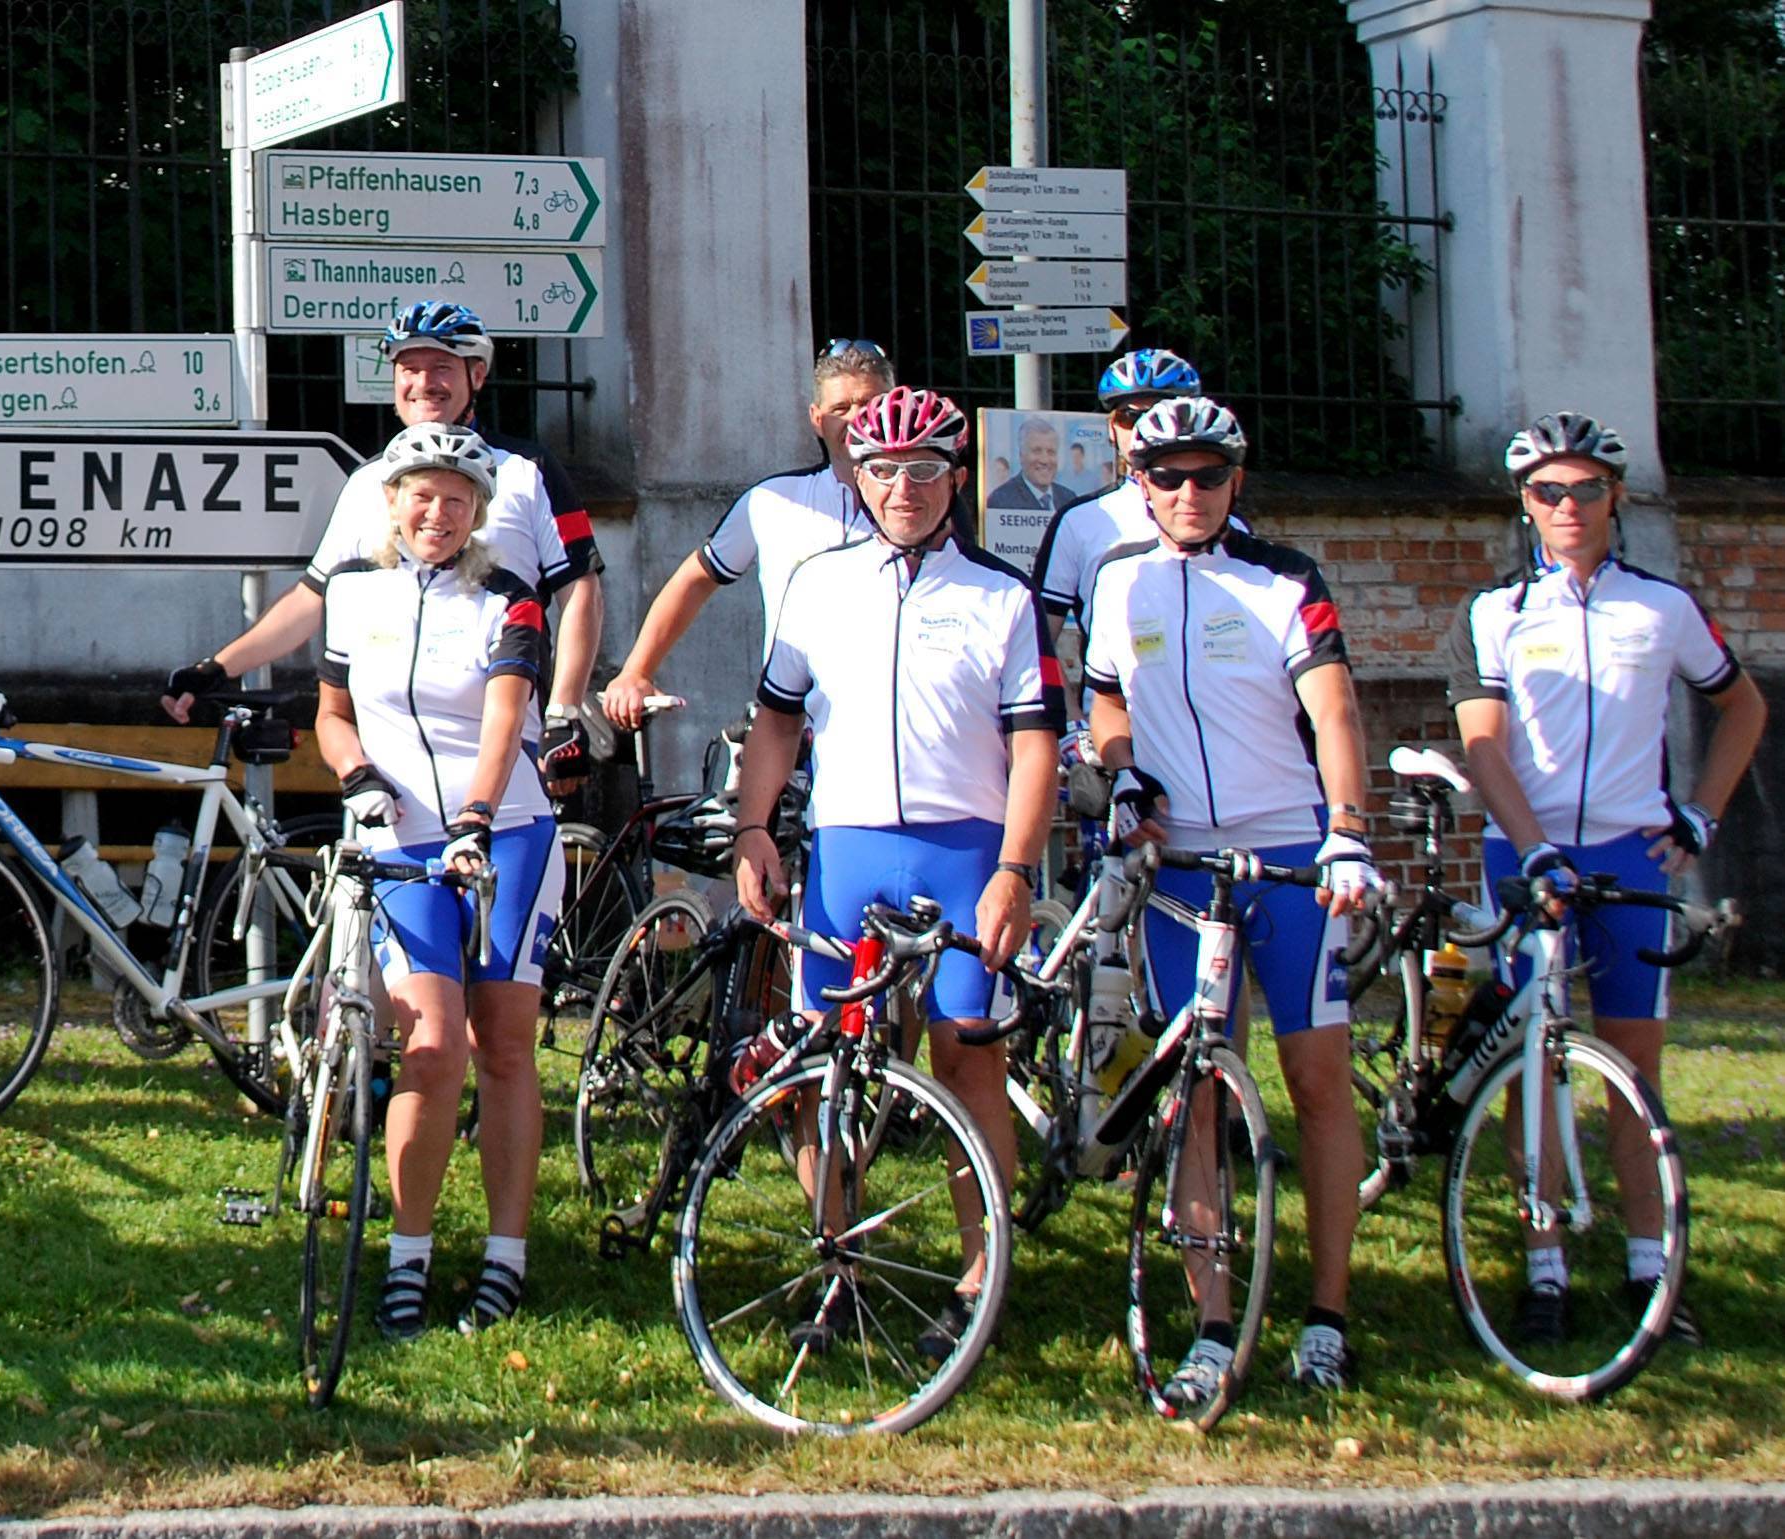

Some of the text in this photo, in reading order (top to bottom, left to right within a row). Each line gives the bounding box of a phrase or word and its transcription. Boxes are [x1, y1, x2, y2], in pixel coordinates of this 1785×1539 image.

[310, 166, 482, 193] Pfaffenhausen
[283, 202, 390, 232] Hasberg
[311, 259, 523, 287] Thannhausen 13
[284, 295, 398, 321] Derndorf
[183, 351, 204, 375] 10
[120, 519, 172, 548] km
[999, 515, 1051, 526] SEEHOFE
